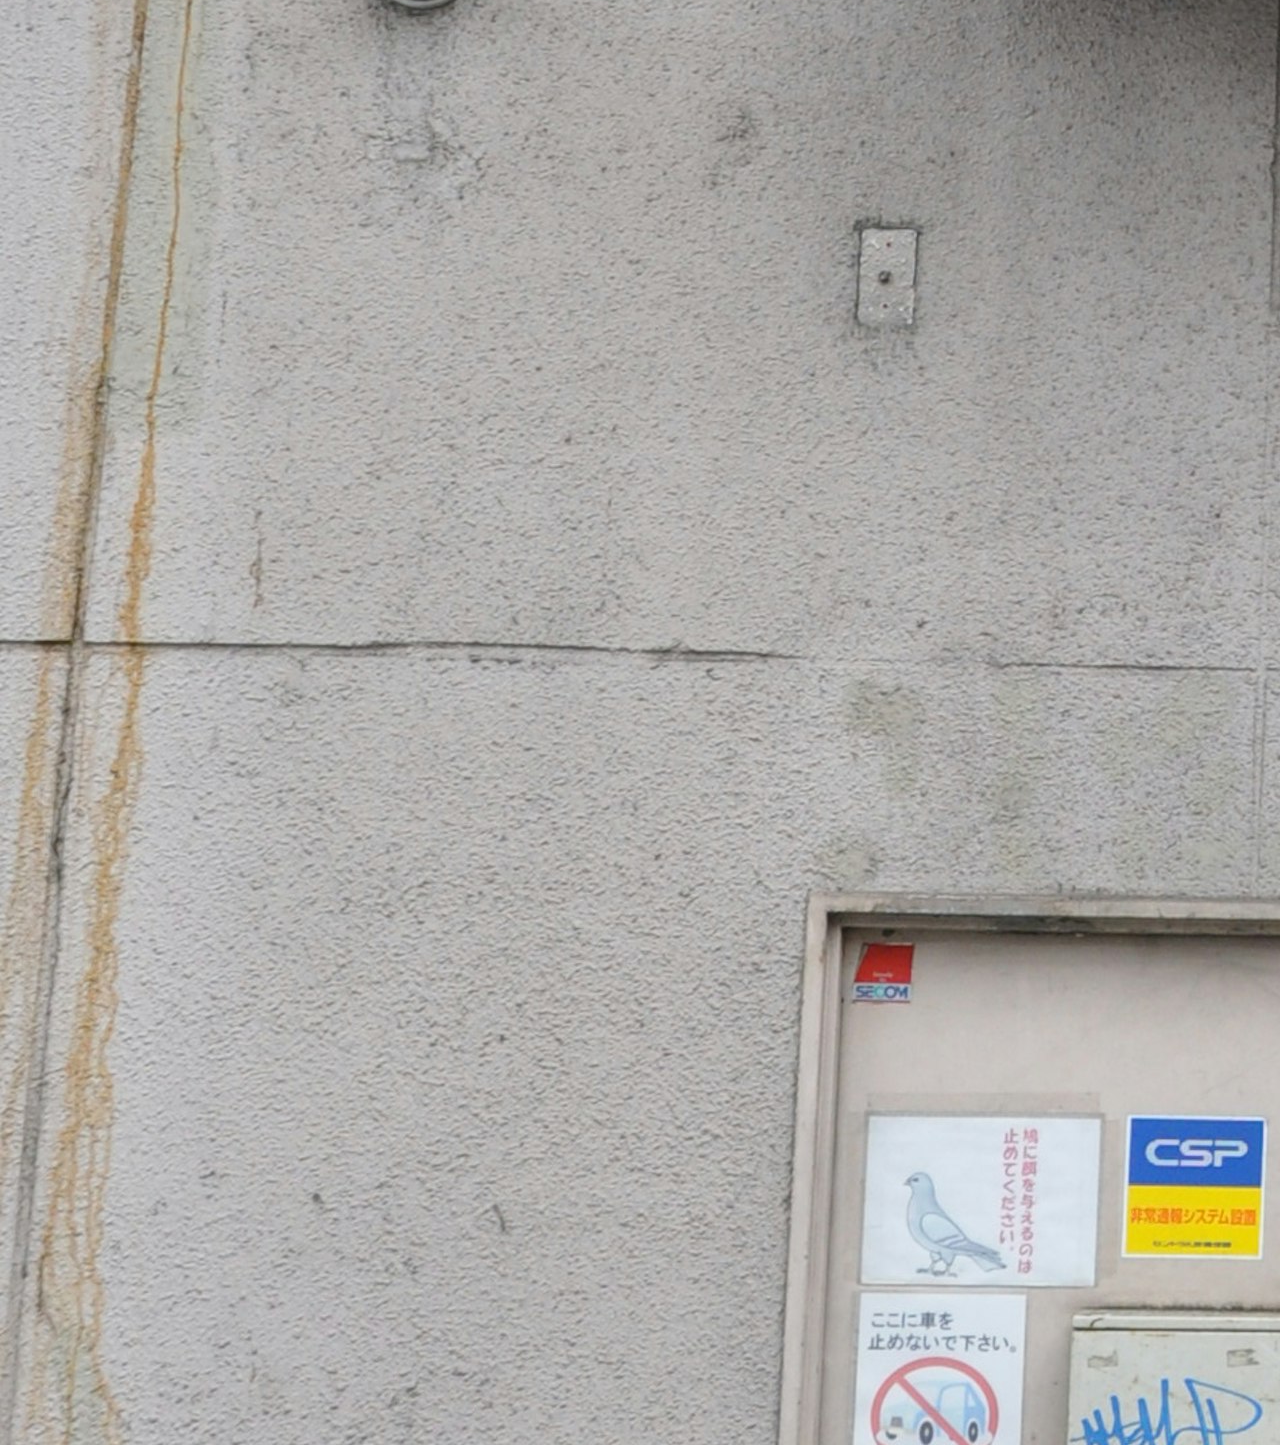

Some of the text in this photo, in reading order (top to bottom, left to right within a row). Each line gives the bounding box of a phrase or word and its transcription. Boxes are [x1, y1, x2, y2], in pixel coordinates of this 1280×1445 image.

[855, 985, 909, 999] SECOM
[1145, 1138, 1248, 1167] CSP
[871, 1311, 955, 1330] ここに車を
[867, 1333, 1017, 1353] 止めないで下さい。
